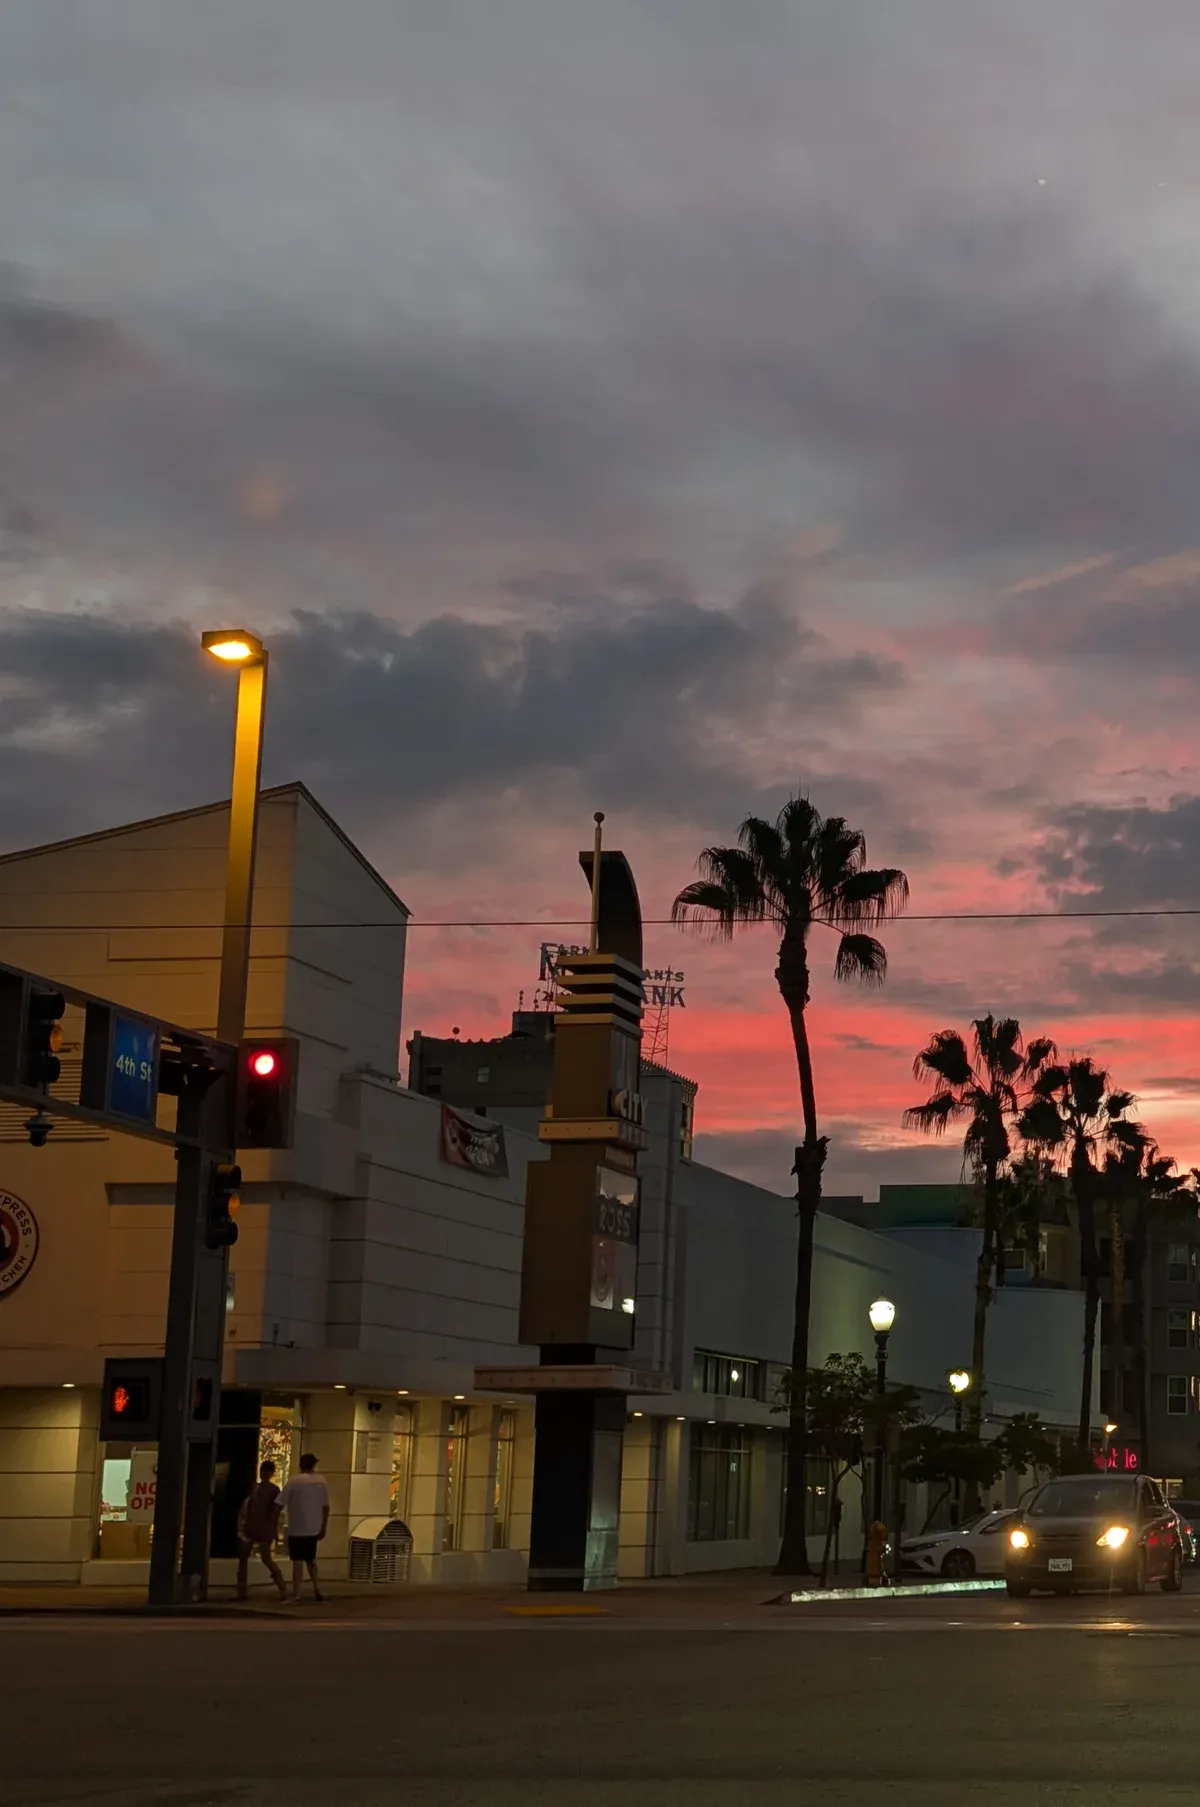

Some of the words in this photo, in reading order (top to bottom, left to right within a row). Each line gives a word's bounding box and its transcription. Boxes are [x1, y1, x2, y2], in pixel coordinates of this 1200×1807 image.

[116, 1054, 136, 1076] 4th
[140, 1062, 152, 1081] St
[614, 1089, 648, 1125] CITY
[0, 1195, 32, 1236] PRESS
[1, 1256, 27, 1284] CHEN
[131, 1497, 154, 1510] OP
